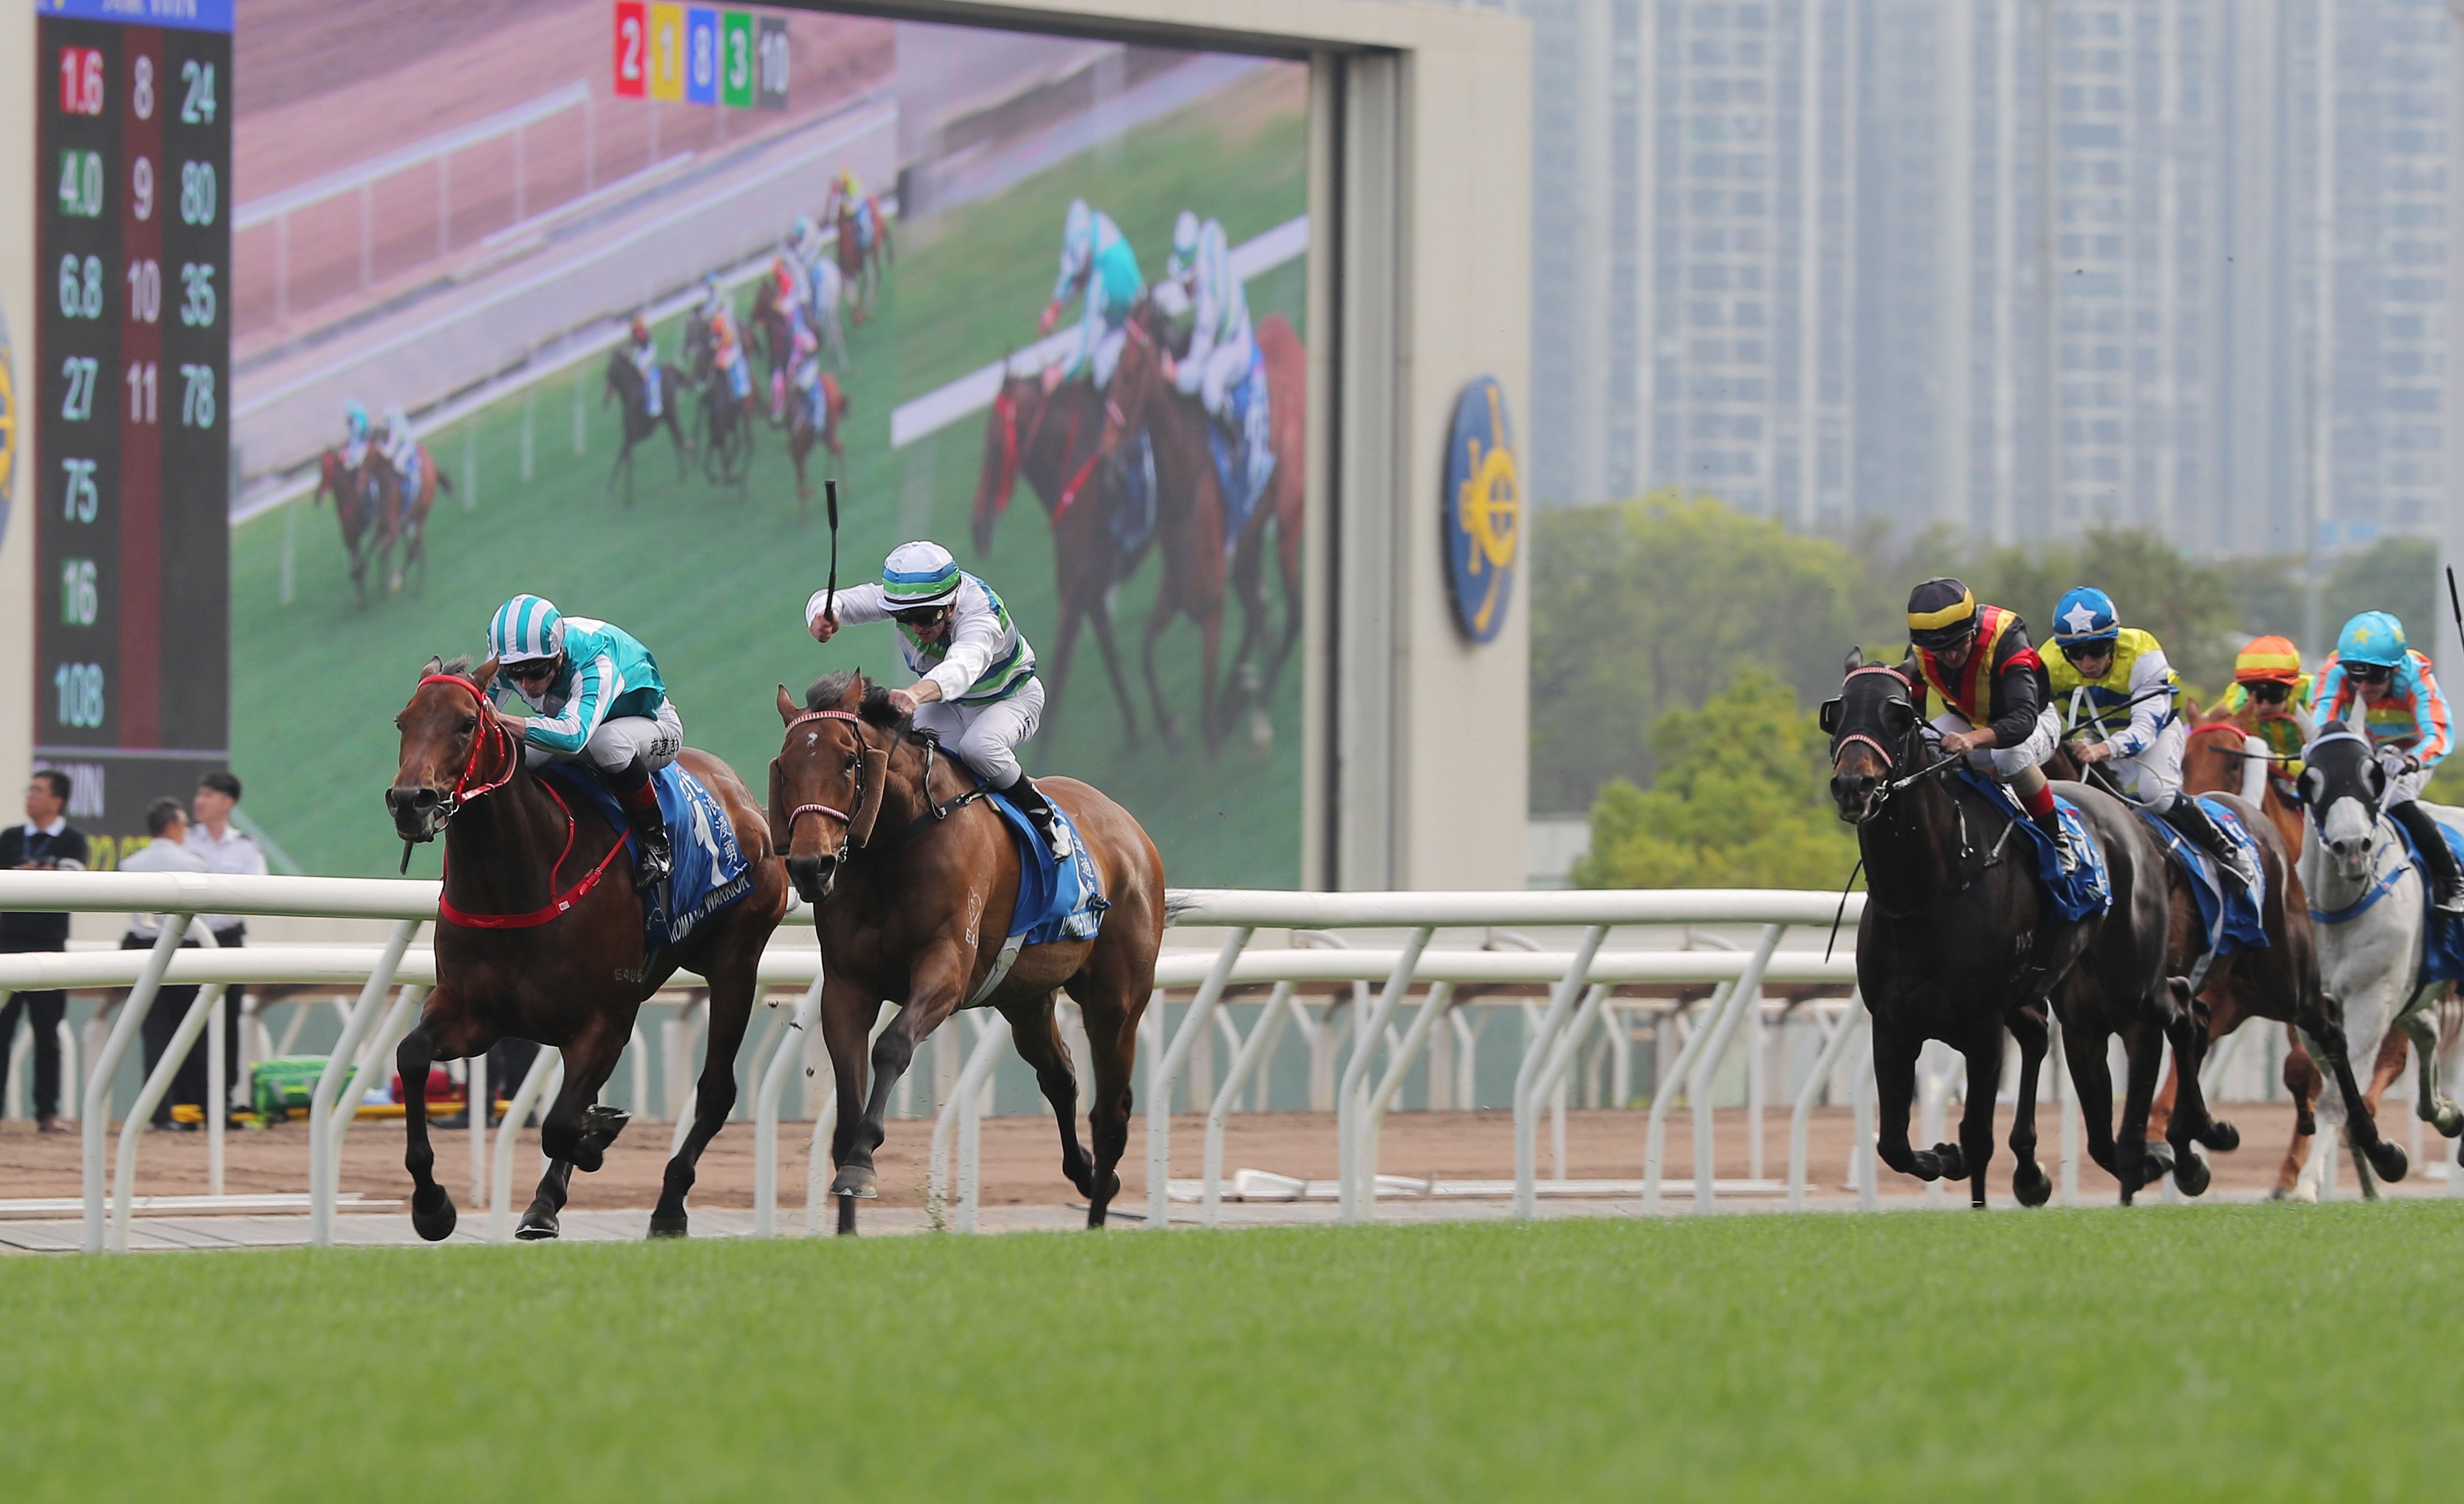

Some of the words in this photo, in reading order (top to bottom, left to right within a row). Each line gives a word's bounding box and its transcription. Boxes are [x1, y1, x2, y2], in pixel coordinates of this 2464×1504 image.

[62, 51, 104, 115] 1.6
[133, 56, 154, 120] 8
[181, 59, 216, 124] 24
[622, 16, 641, 80] 2
[659, 22, 674, 84] 1
[693, 25, 713, 87] 8
[729, 27, 748, 90] 3
[760, 30, 791, 95] 10
[133, 156, 154, 221] 9
[180, 160, 216, 226] 80
[59, 253, 103, 319] 6.8
[127, 259, 161, 324] 10
[180, 262, 216, 327] 35
[62, 356, 98, 420] 27
[126, 361, 157, 425] 11
[179, 363, 216, 430] 78
[62, 457, 98, 523] 75
[63, 560, 98, 625] 16
[55, 662, 104, 728] 108
